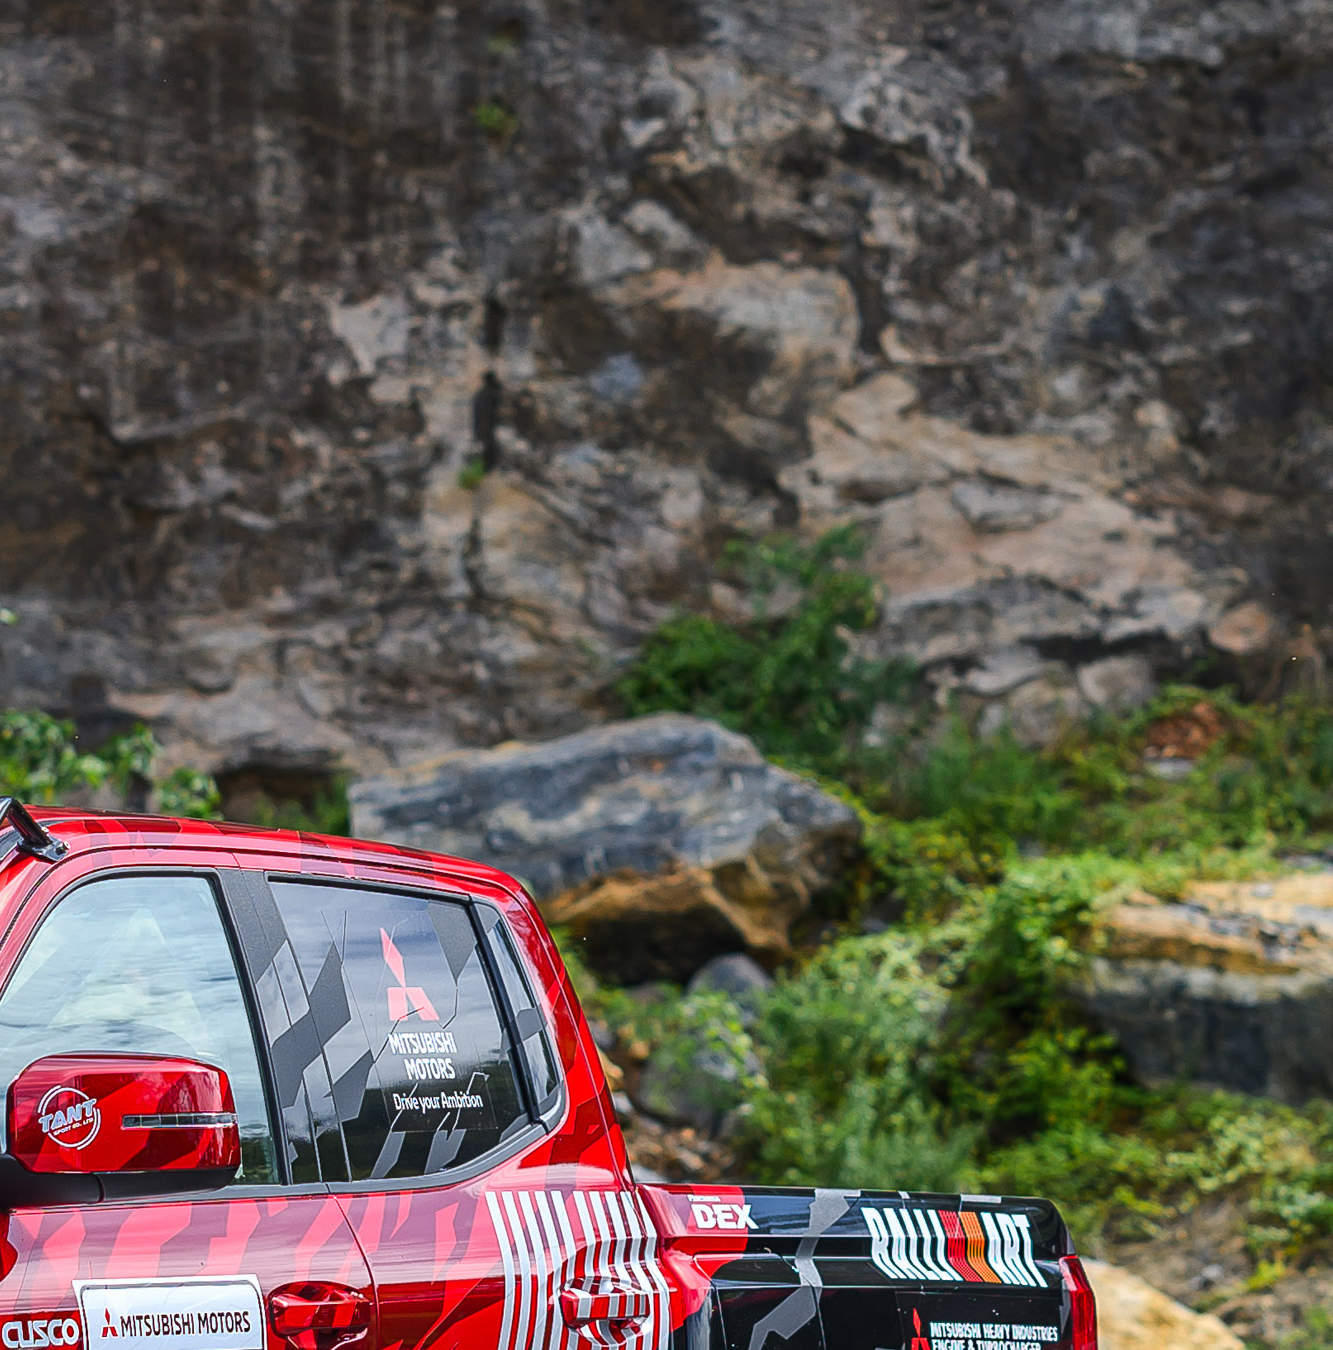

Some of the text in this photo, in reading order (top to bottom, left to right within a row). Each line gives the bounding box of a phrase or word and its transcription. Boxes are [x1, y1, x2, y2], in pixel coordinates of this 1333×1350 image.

[388, 1032, 457, 1054] MITSUBISHI
[404, 1058, 455, 1080] MOTORS
[393, 1090, 483, 1114] Drive your Ambition
[38, 1098, 97, 1133] TANT
[691, 1203, 760, 1230] DEX
[0, 1318, 80, 1349] CUSCO
[120, 1310, 251, 1338] MITSUBISHI MOTORS
[930, 1322, 1058, 1342] MITSUBISHI HEAVY INDUSTRIES
